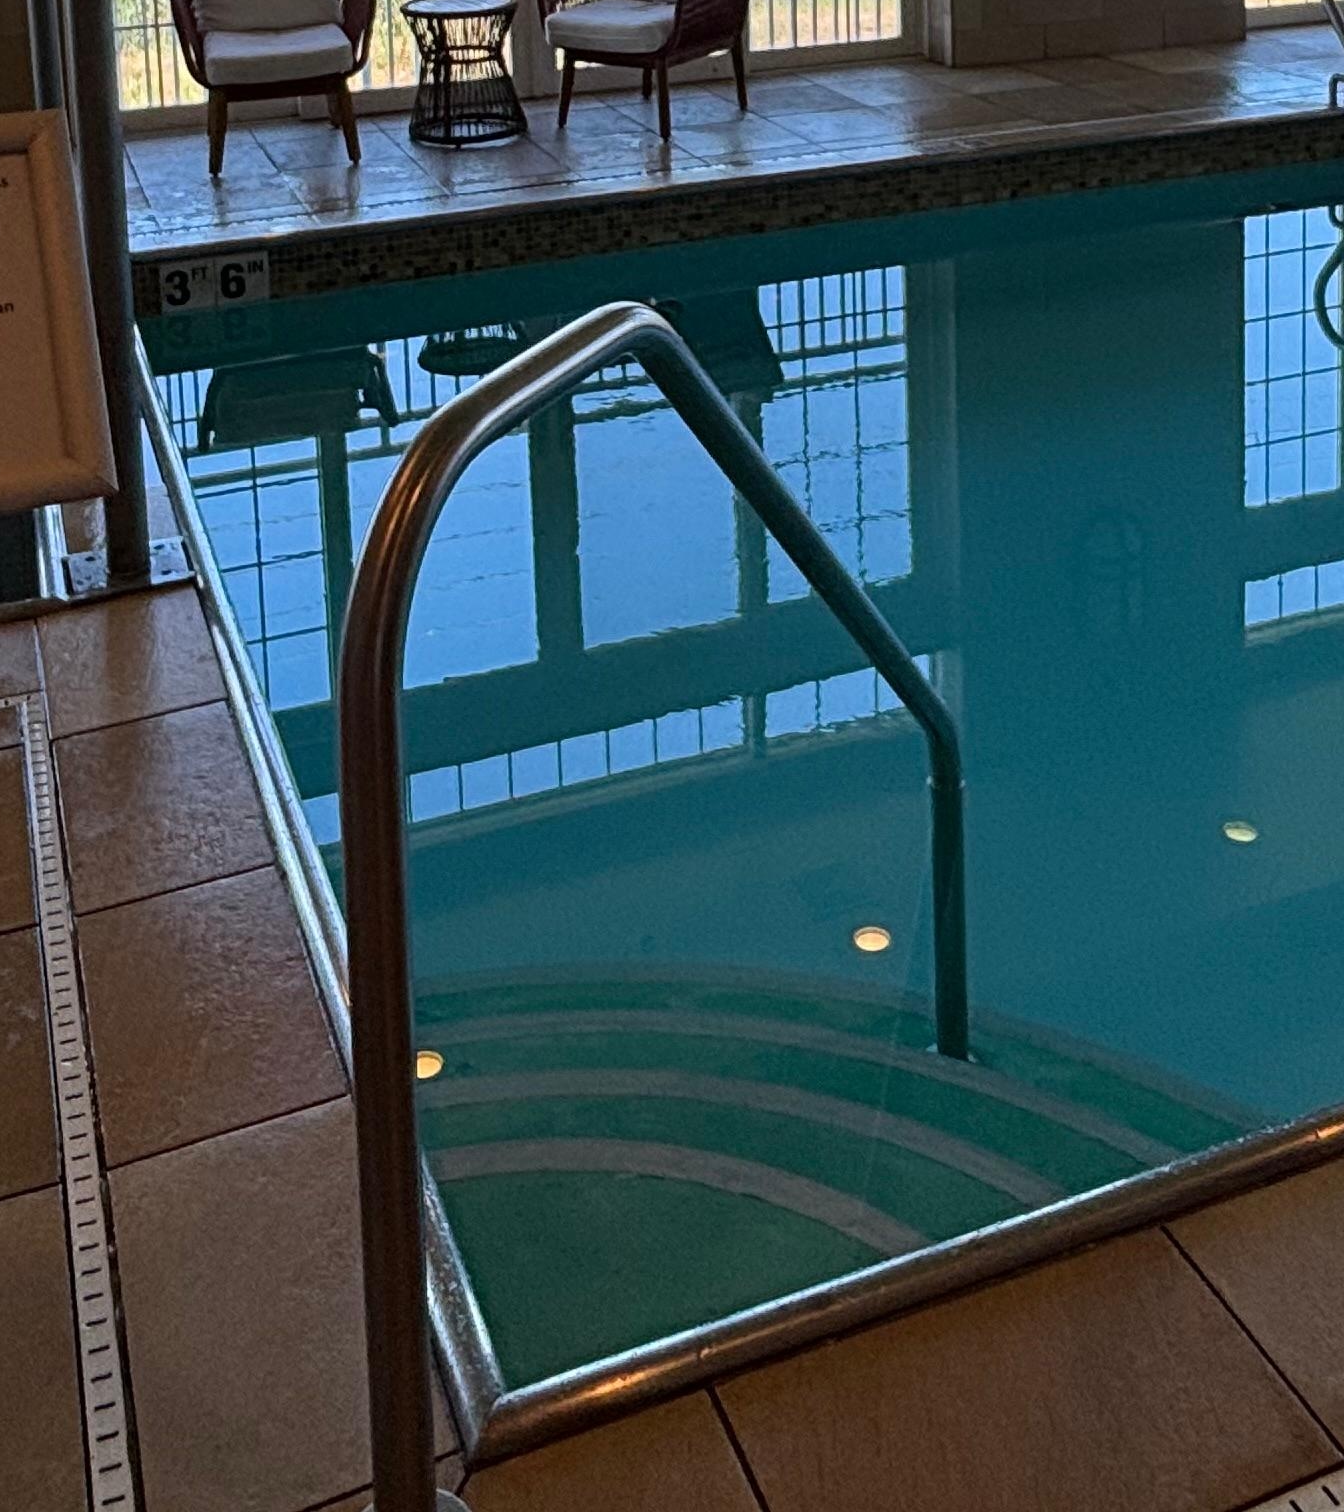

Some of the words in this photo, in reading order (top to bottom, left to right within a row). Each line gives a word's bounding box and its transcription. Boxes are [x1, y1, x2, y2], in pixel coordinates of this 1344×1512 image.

[165, 269, 191, 306] 3
[191, 266, 207, 281] FT
[220, 262, 247, 299] 6
[248, 259, 264, 274] IN
